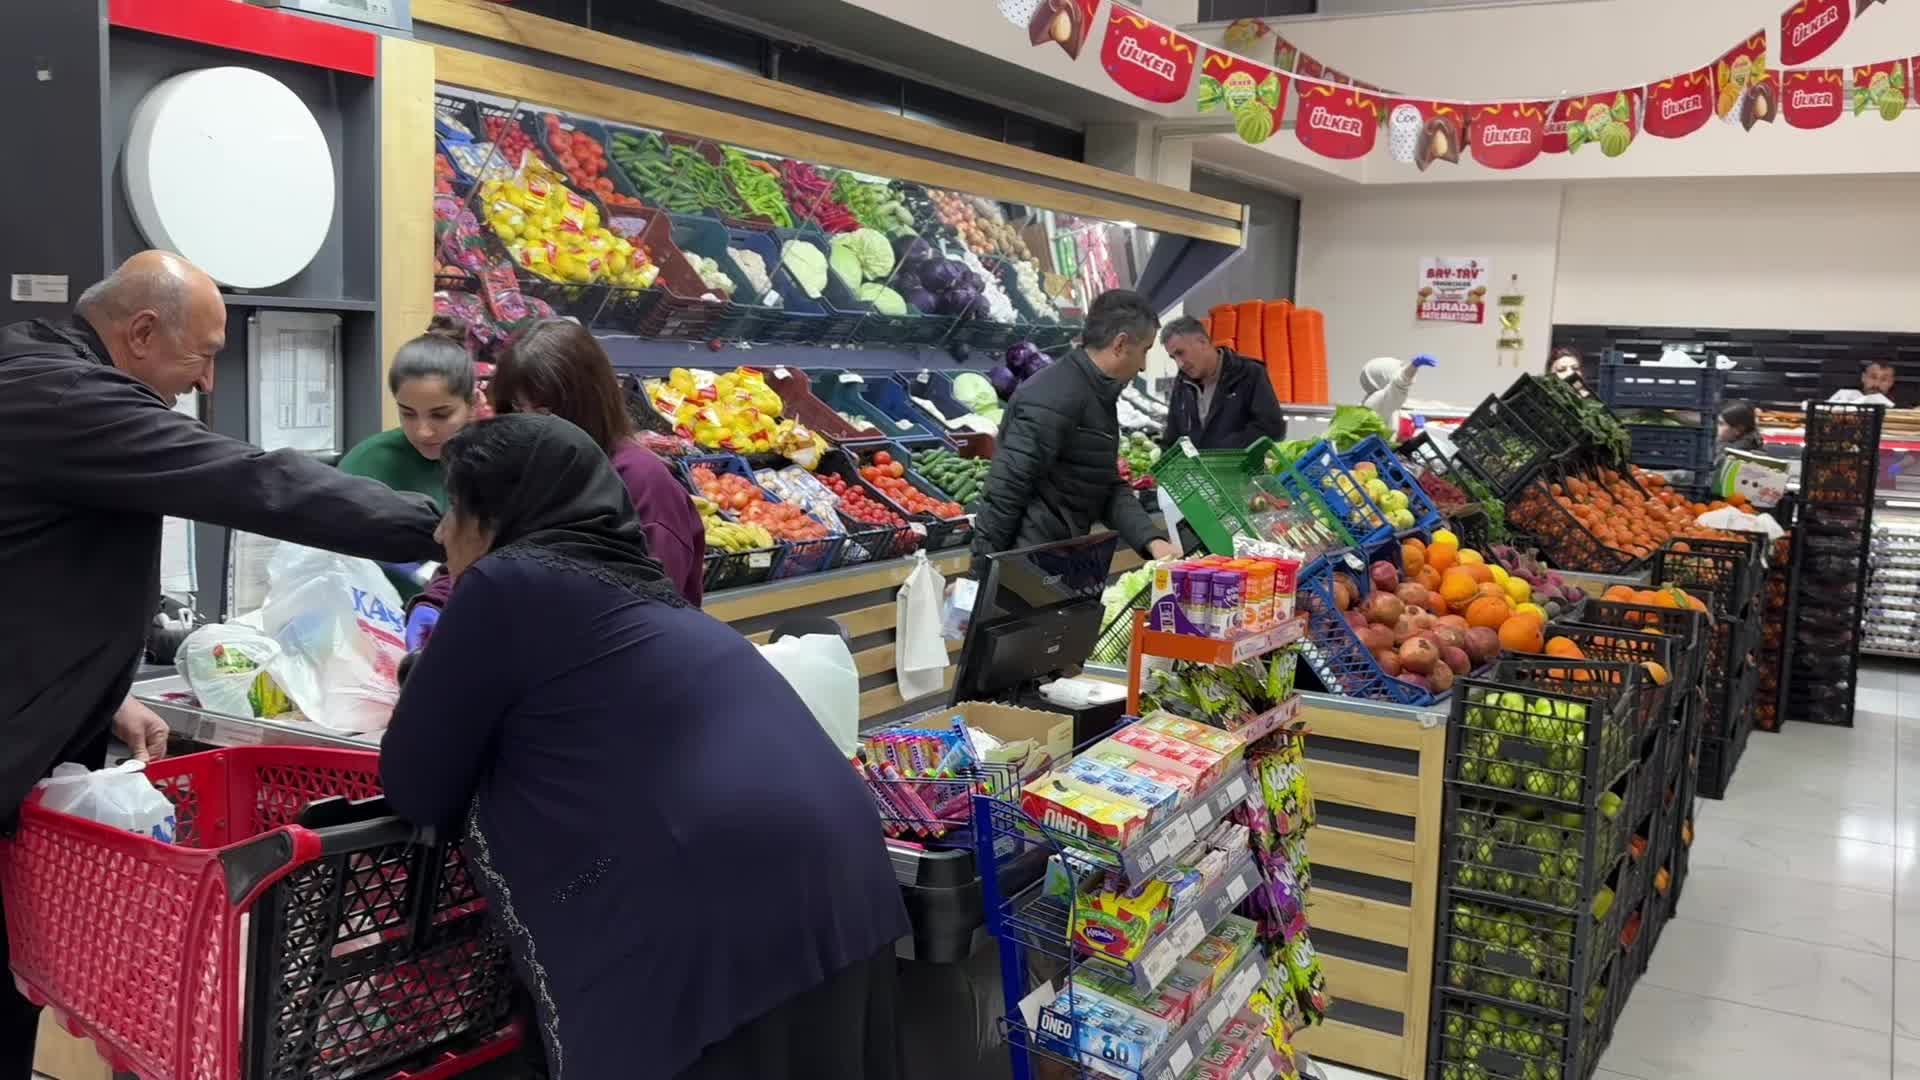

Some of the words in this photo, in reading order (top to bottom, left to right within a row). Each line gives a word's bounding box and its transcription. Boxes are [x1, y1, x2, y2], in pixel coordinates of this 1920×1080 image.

[1118, 37, 1176, 81] ÜLKER
[1662, 95, 1702, 119] ÜLKER
[1792, 90, 1833, 108] ÜLKER
[1311, 107, 1362, 136] ÜLKER
[1484, 125, 1531, 146] ÜLKER
[1422, 302, 1477, 312] BURADA
[1102, 1034, 1140, 1064] 60
